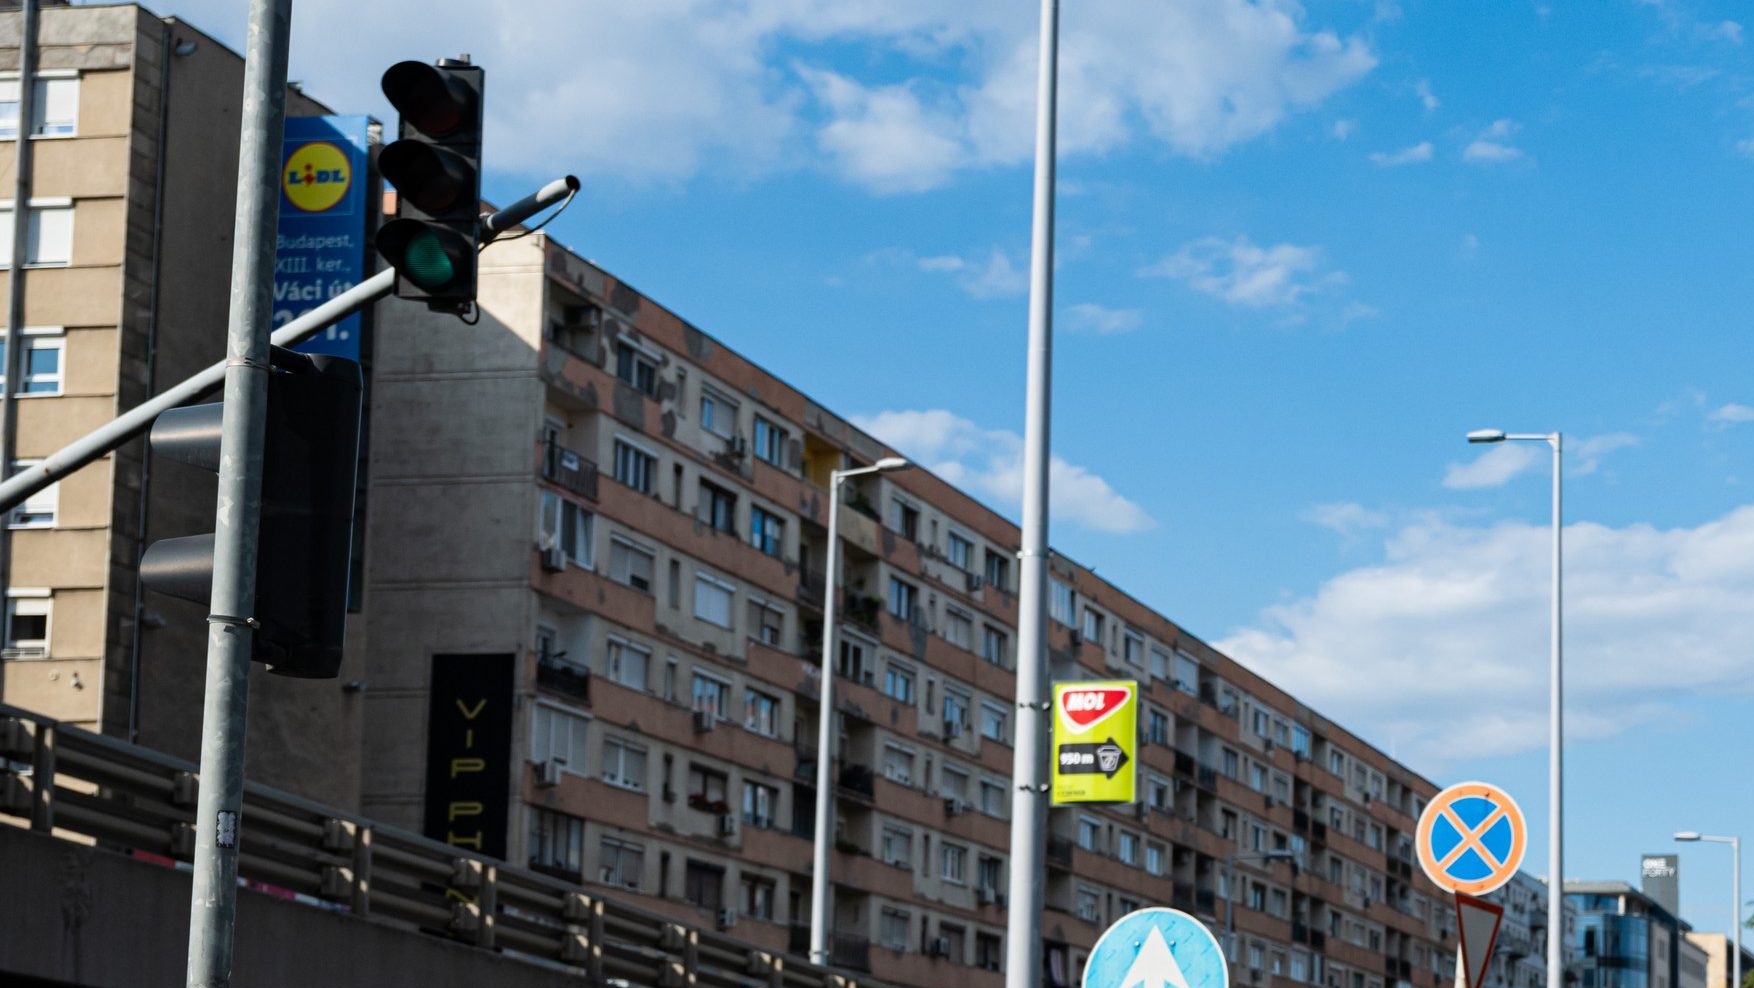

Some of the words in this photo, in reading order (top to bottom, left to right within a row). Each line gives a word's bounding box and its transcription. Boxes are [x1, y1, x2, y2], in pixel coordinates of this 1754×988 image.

[273, 278, 322, 301] Váci
[1066, 692, 1105, 711] MOL
[1081, 754, 1094, 764] m
